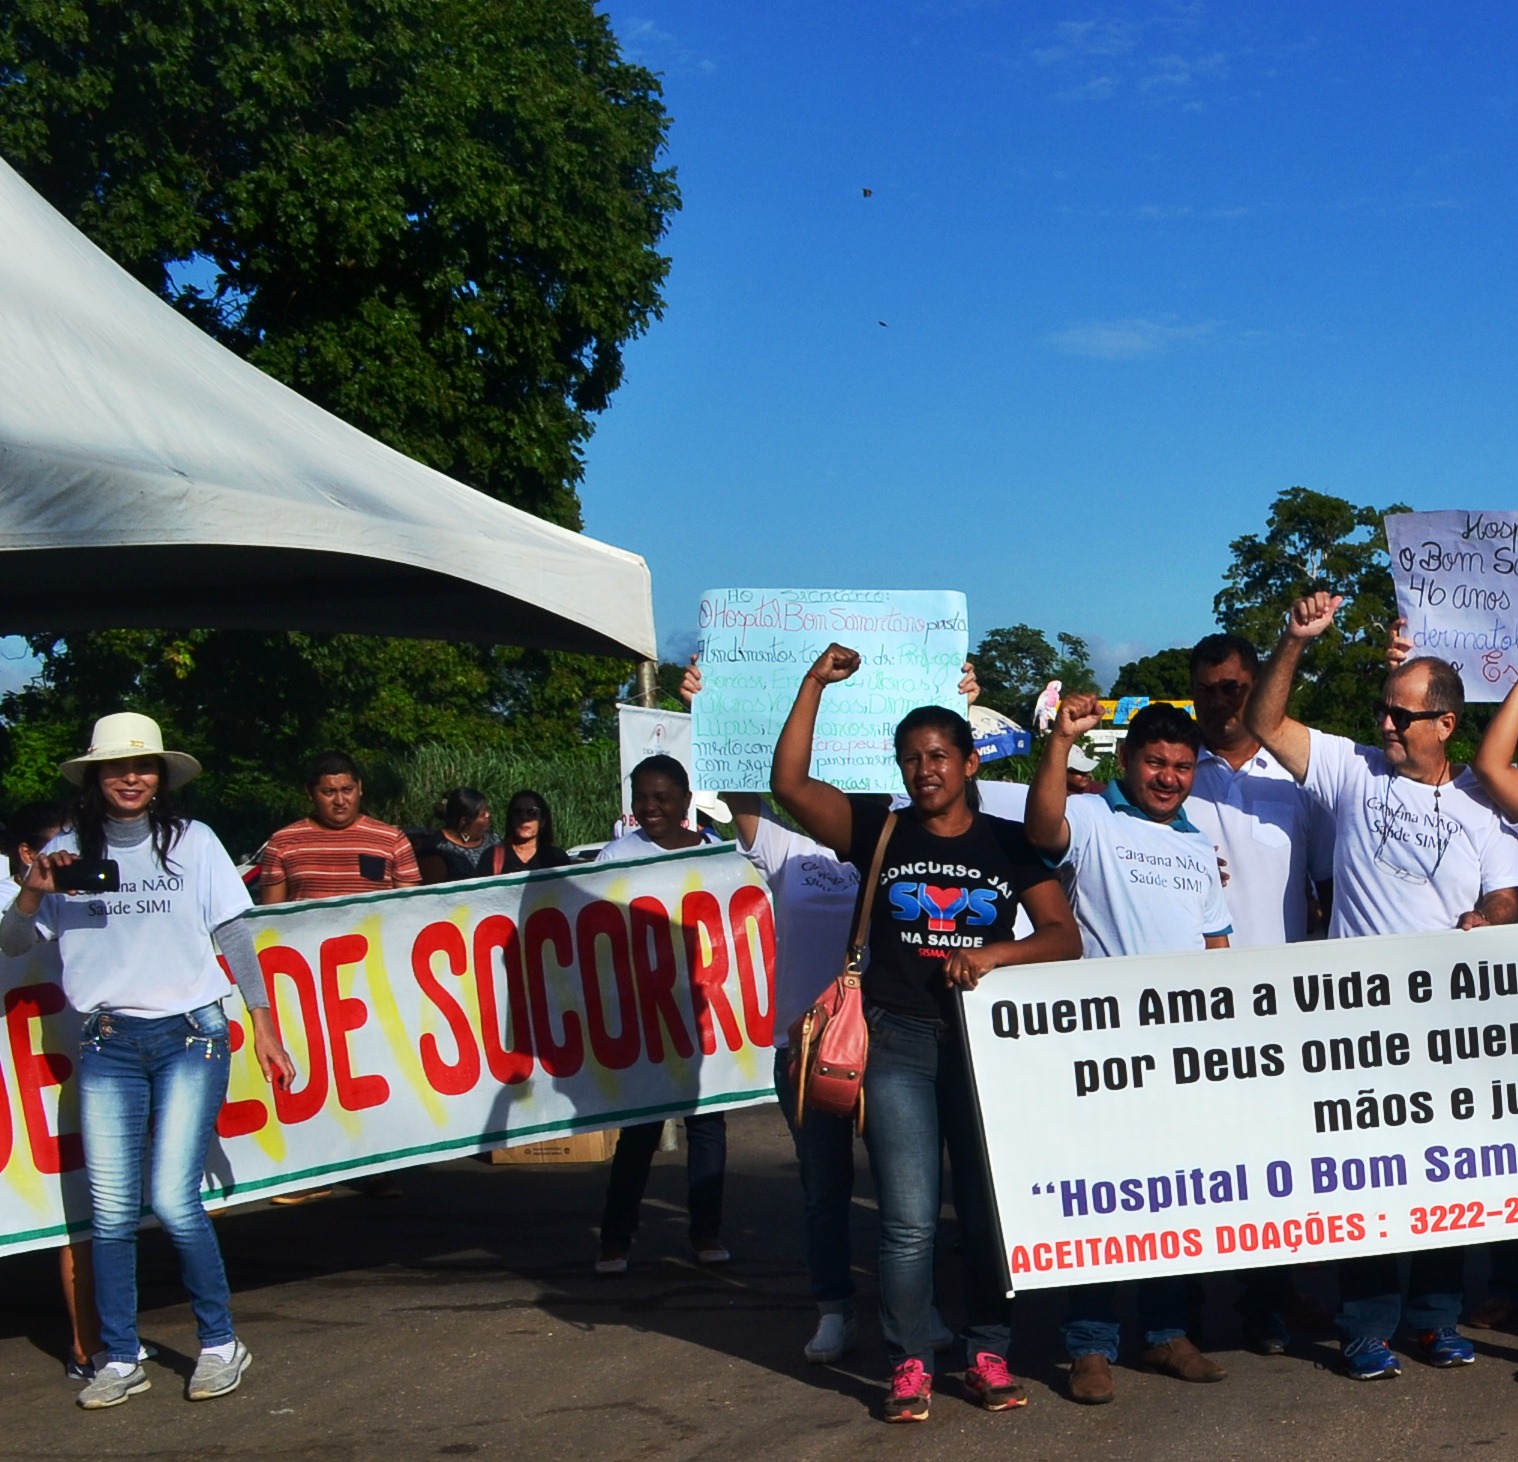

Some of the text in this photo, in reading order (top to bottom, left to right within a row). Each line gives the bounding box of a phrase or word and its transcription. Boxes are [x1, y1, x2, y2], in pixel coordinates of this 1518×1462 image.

[1399, 547, 1416, 572] O
[1419, 541, 1485, 574] Bom
[1409, 575, 1446, 608] 46
[1452, 584, 1511, 612] anos
[713, 596, 782, 648] Hospital
[784, 602, 828, 632] Bom
[829, 607, 925, 632] Samaritano
[695, 758, 731, 771] com
[977, 744, 998, 756] VISA
[142, 875, 184, 892] NÃO!
[881, 861, 981, 885] CONCURSO
[1130, 869, 1202, 894] Saúde SIM!
[88, 900, 171, 917] Saúde SIM!
[901, 932, 983, 948] NA SAÚDE
[411, 886, 775, 1096] SOCORRO
[992, 996, 1120, 1039] Quem
[1139, 987, 1235, 1026] Ama
[1253, 983, 1277, 1016] a
[1293, 971, 1390, 1012] Vida
[1408, 970, 1432, 1003] e
[1074, 1055, 1155, 1097] por
[1173, 1044, 1284, 1084] Deus
[1302, 1030, 1410, 1073] onde
[1314, 1089, 1434, 1133] mãos
[1451, 1088, 1474, 1120] e
[1267, 1161, 1293, 1197] O
[1311, 1154, 1407, 1194] Bom
[1012, 1229, 1202, 1273] ACEITAMOS
[1216, 1212, 1365, 1253] DOAÇÕES
